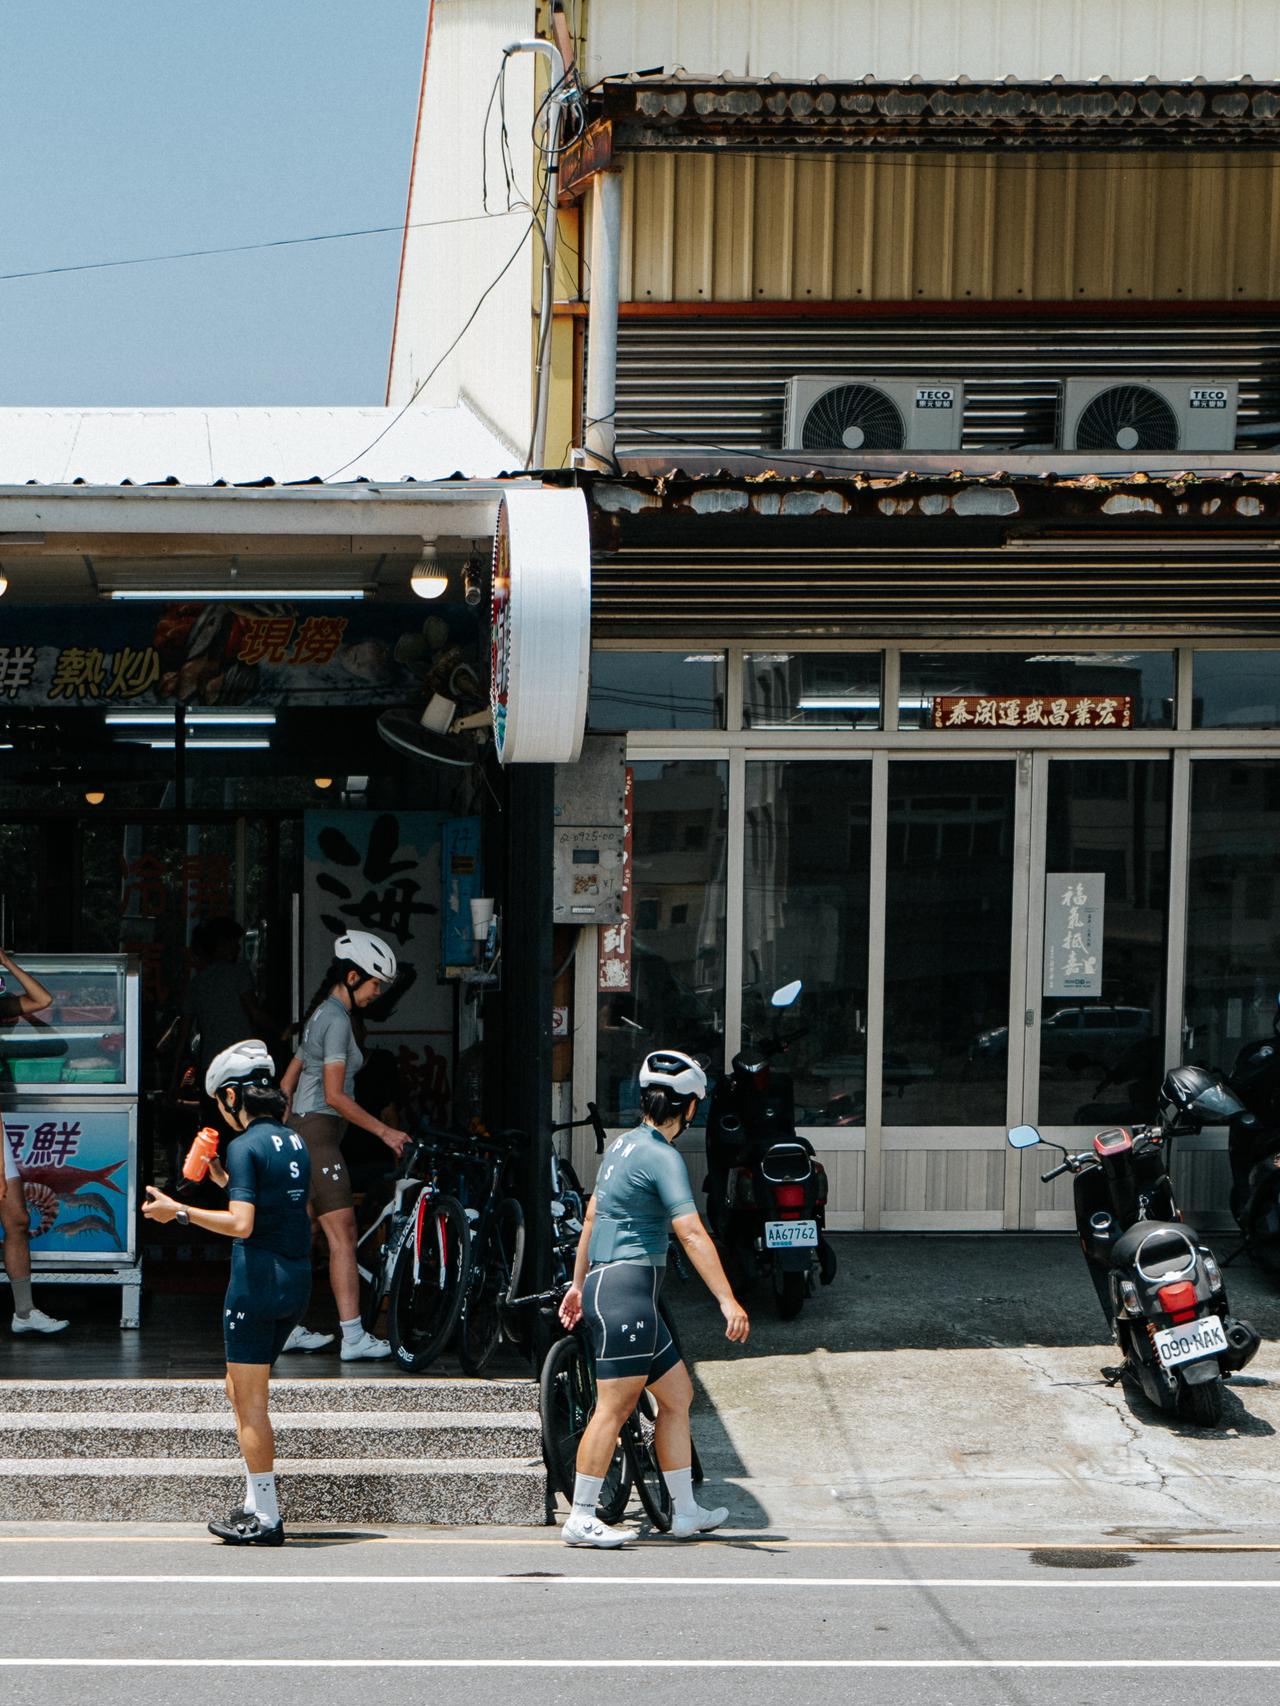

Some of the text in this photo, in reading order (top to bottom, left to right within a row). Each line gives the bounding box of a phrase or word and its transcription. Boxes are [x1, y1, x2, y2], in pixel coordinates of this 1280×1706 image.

[919, 391, 951, 399] TECO
[1193, 391, 1225, 399] TECO
[239, 616, 349, 666] 現撈
[49, 647, 161, 699] 熱炒
